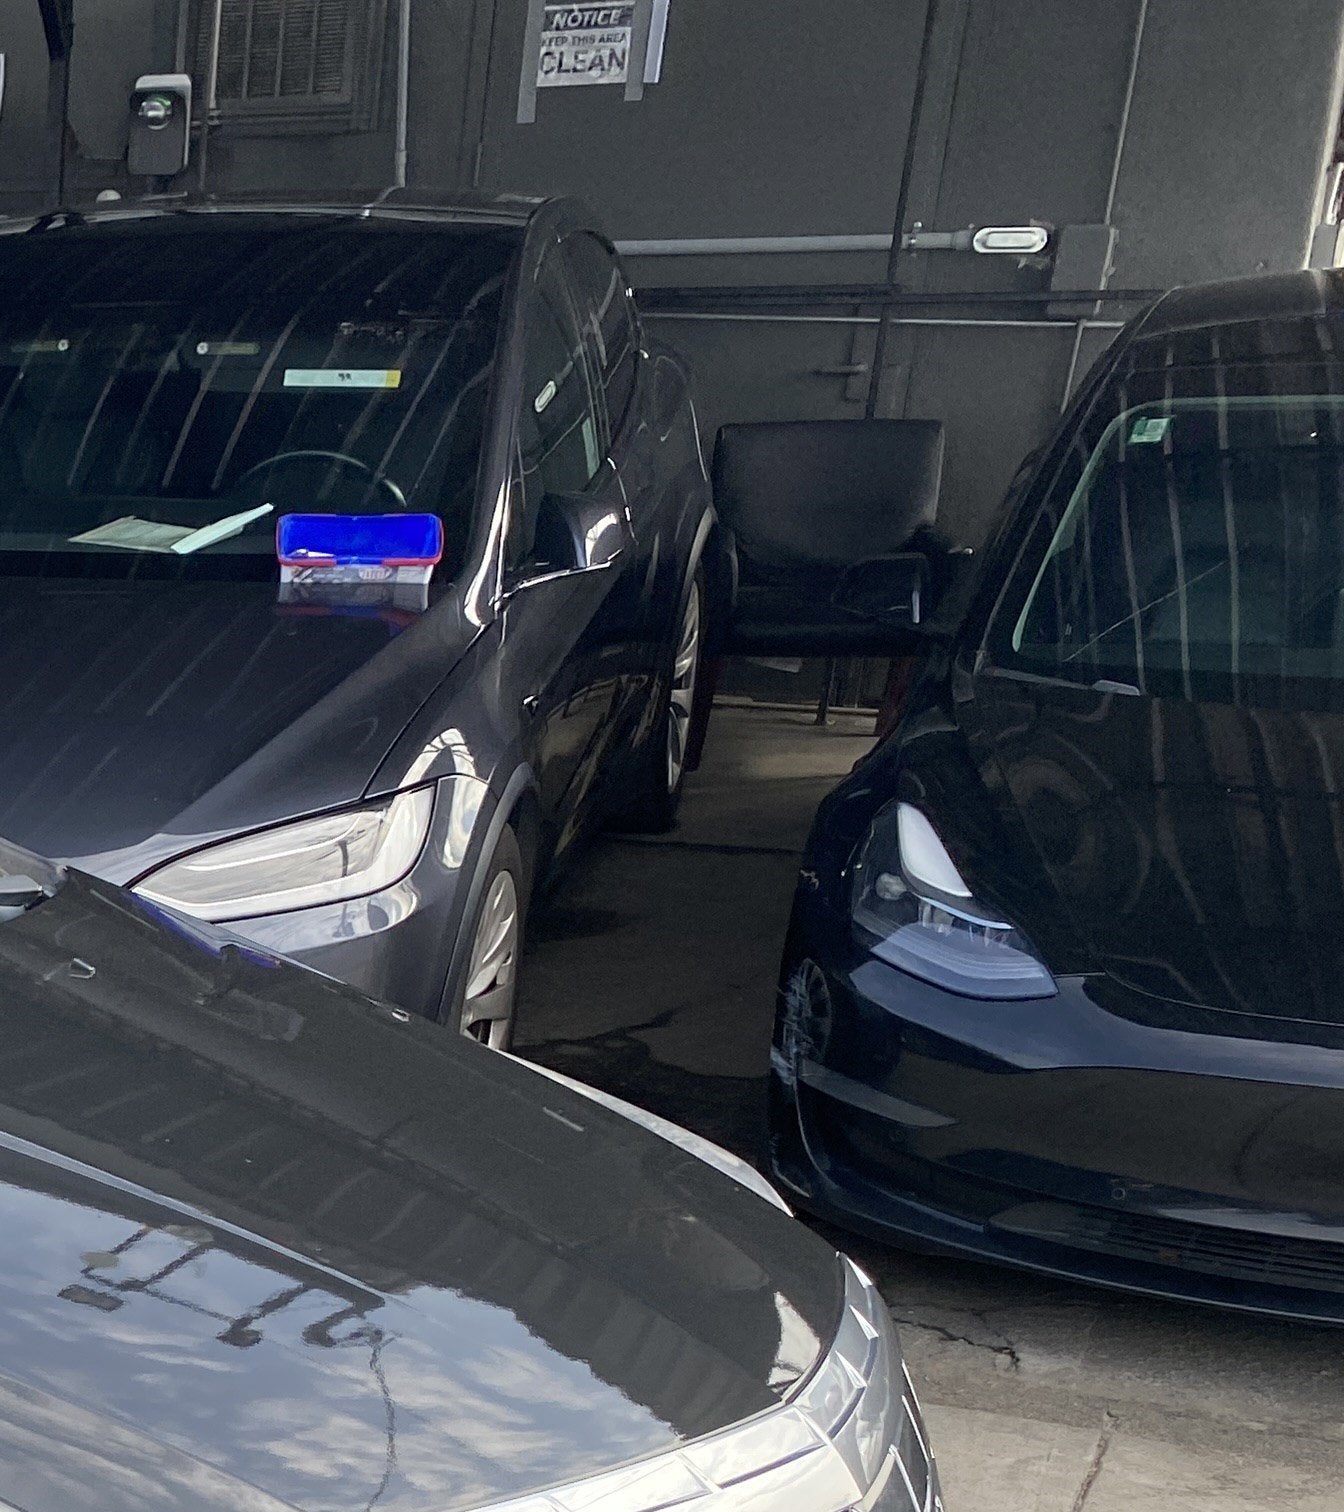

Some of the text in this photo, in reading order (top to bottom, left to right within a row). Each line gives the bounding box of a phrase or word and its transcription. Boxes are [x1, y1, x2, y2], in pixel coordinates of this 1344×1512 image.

[551, 8, 623, 30] NOTICE
[572, 34, 596, 46] THIS
[599, 32, 626, 43] AREA
[540, 48, 626, 75] CLEAN
